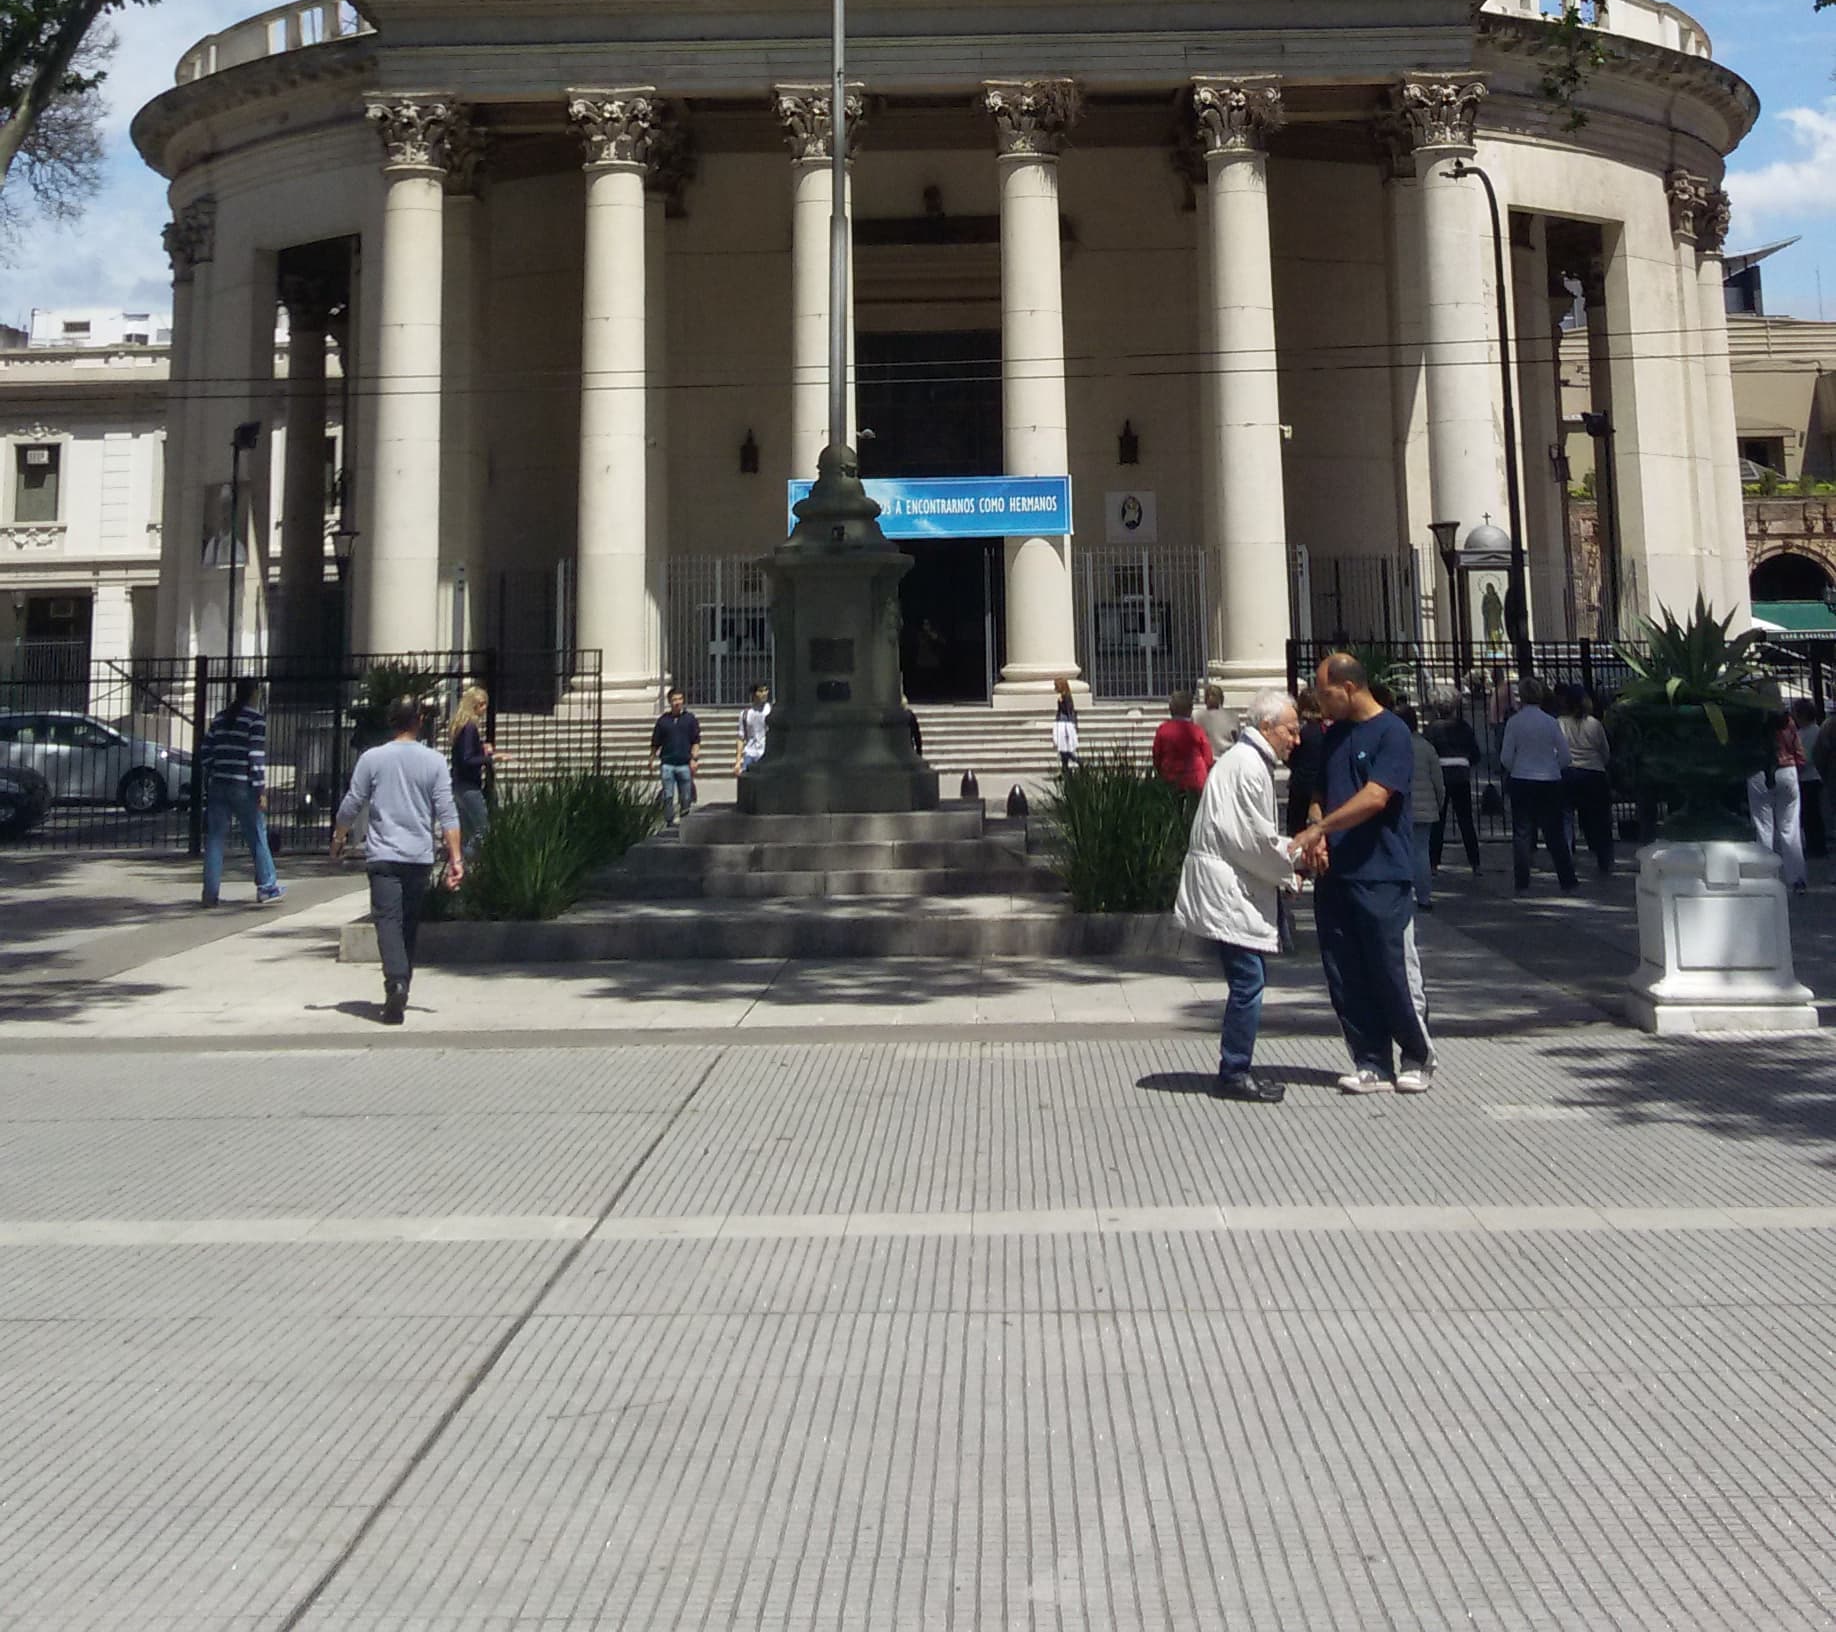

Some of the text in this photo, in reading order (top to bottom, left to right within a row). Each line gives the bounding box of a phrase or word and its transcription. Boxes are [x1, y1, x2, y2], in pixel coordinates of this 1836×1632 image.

[895, 499, 902, 515] A
[906, 497, 975, 515] ENCONTRARNOS
[979, 497, 1005, 514] COMO
[1009, 495, 1057, 512] HERMANOS
